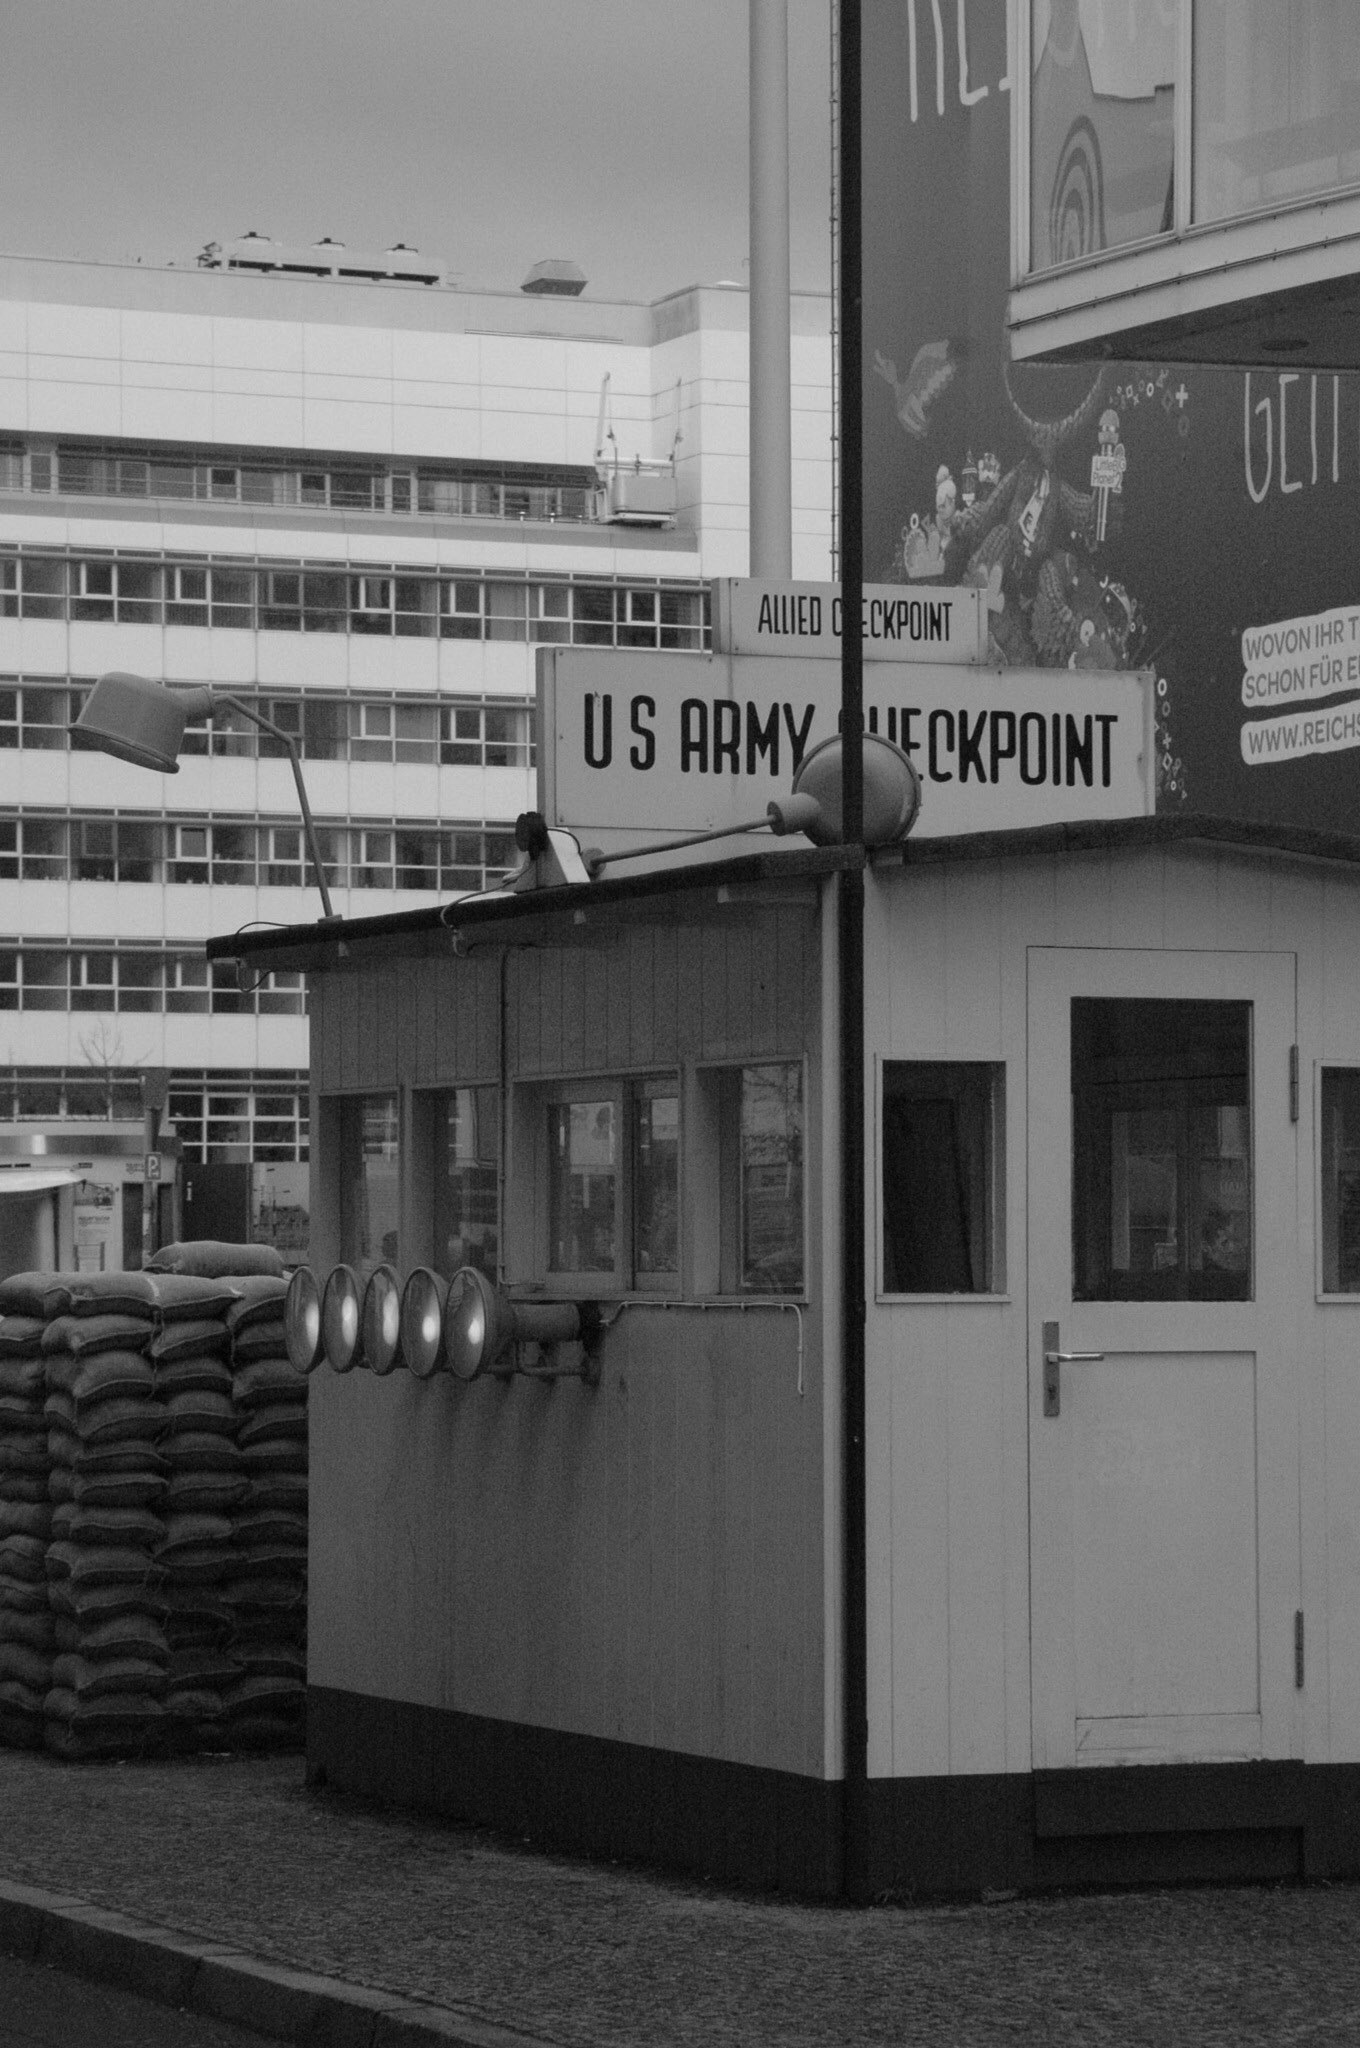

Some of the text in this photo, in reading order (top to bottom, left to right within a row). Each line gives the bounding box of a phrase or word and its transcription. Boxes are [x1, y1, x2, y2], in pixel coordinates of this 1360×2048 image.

[757, 593, 953, 642] ALLIED CECKPOINT
[1246, 626, 1311, 661] WOVON
[1315, 619, 1344, 648] IHR
[1246, 654, 1360, 699] SCHON FÜR E
[680, 698, 816, 778] ARMY
[836, 705, 1119, 788] ECKPOINT
